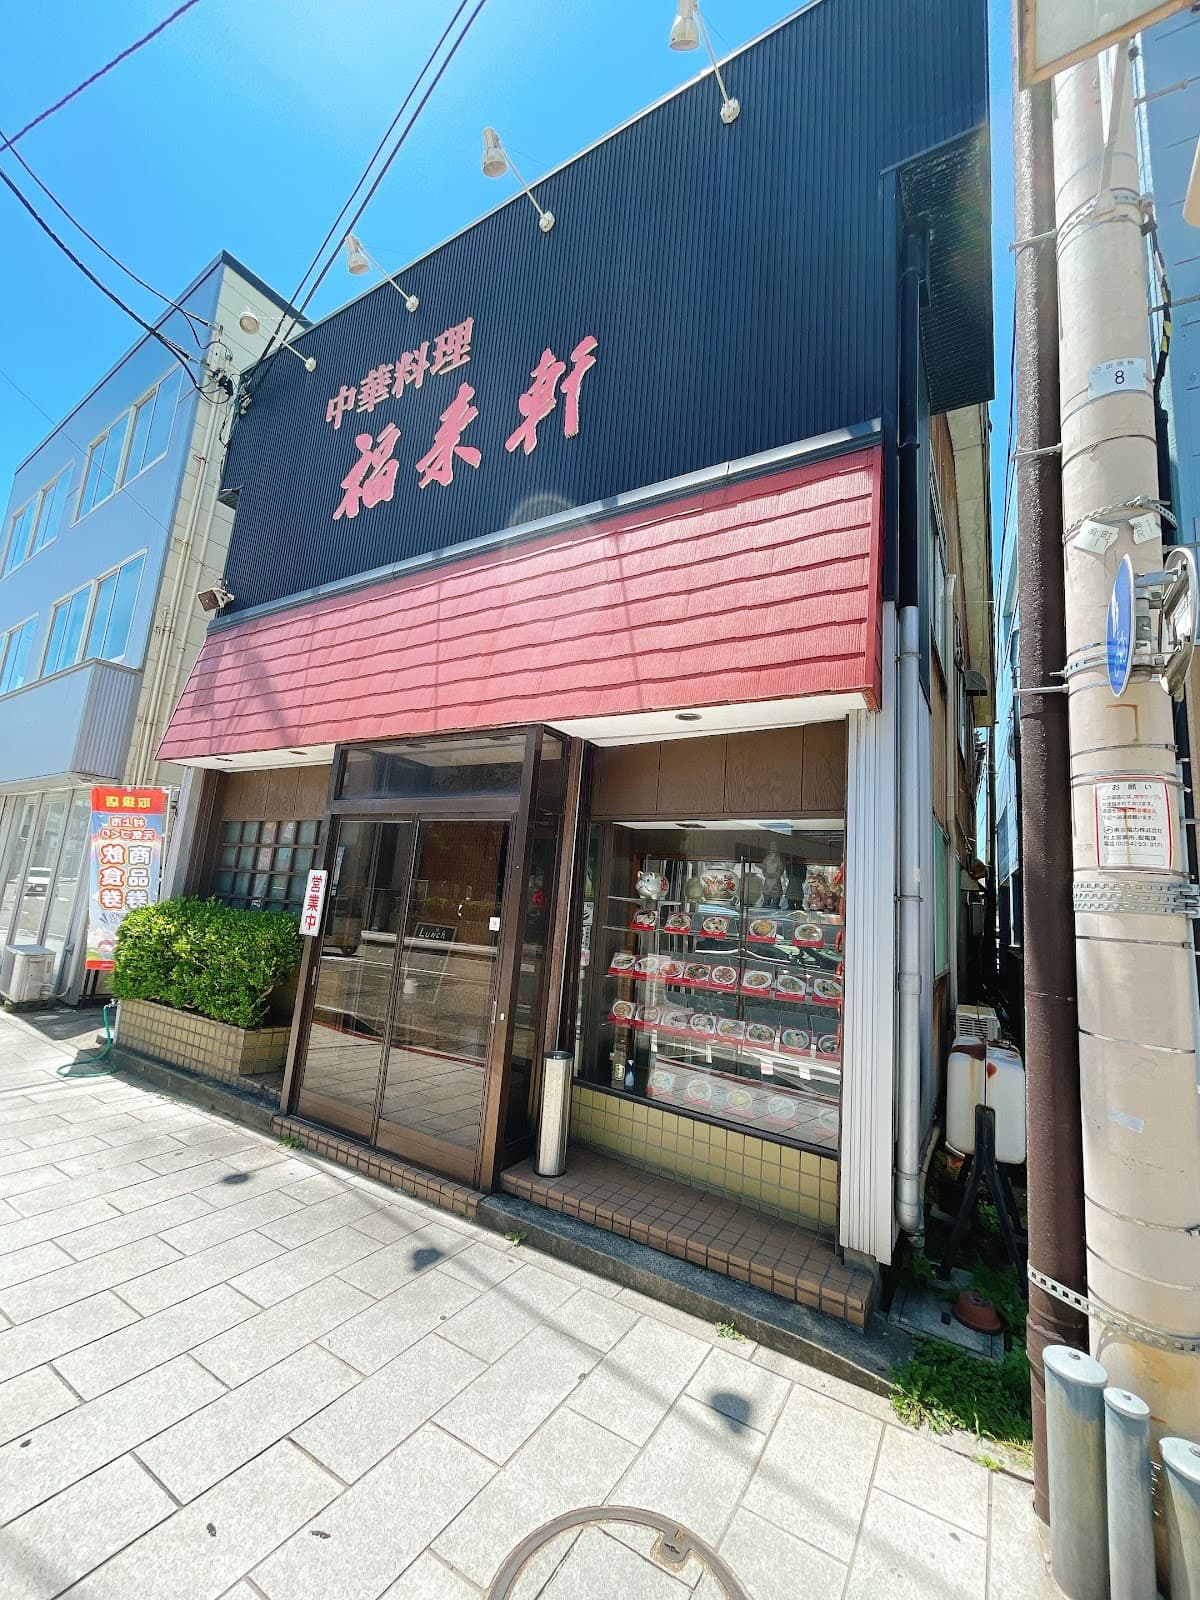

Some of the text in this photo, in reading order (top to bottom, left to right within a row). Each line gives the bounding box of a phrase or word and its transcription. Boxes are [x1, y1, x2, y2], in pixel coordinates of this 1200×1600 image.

[326, 317, 474, 429] 中華料理
[1115, 370, 1125, 385] 8
[305, 875, 322, 930] 営業中
